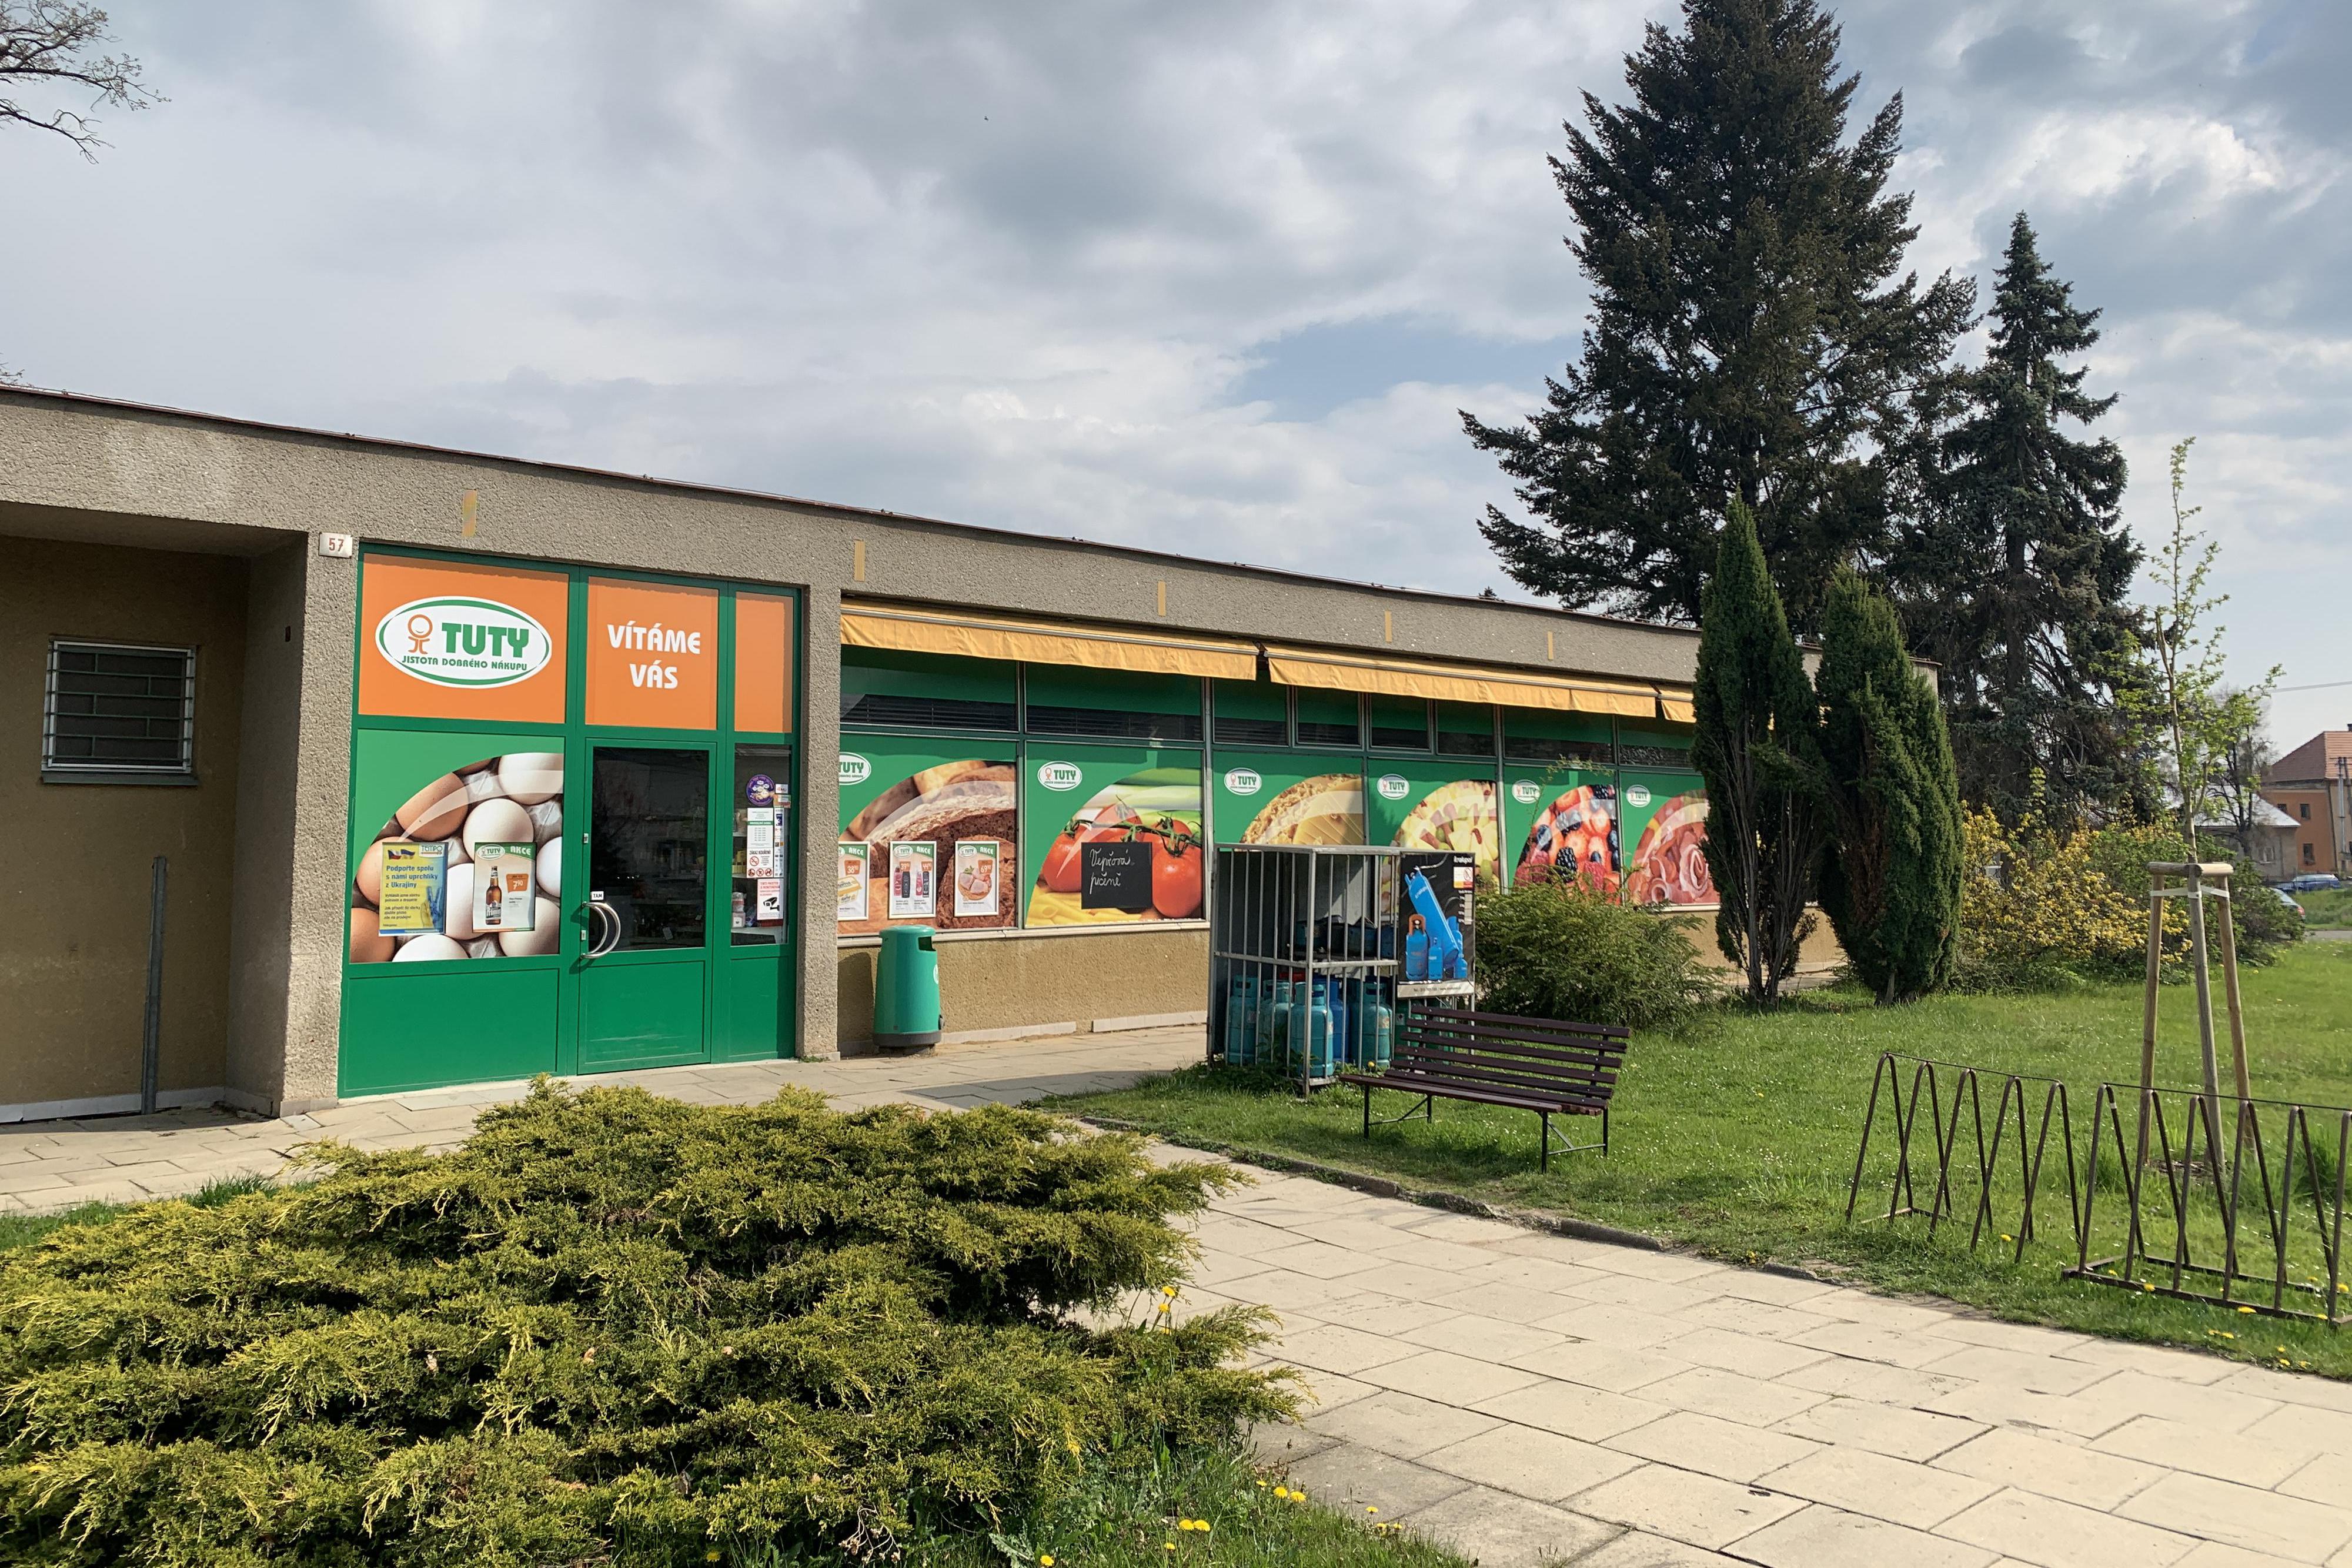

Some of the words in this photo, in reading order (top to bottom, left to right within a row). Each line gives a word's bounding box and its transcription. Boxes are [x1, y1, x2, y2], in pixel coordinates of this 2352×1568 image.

[329, 537, 344, 551] 57
[442, 622, 529, 658] TUTY
[607, 620, 701, 654] VÍTÁME
[402, 656, 439, 666] JISTOTA
[442, 658, 488, 668] DOBRÉHO
[491, 660, 527, 671] NÁKUPU
[629, 660, 678, 689] VÁS
[1053, 770, 1076, 780] TUTY
[1238, 775, 1257, 785] TUTY
[1388, 781, 1405, 791] TUTY
[510, 845, 532, 855] AKCE
[848, 847, 864, 856] AKCE
[916, 846, 931, 854] AKCE
